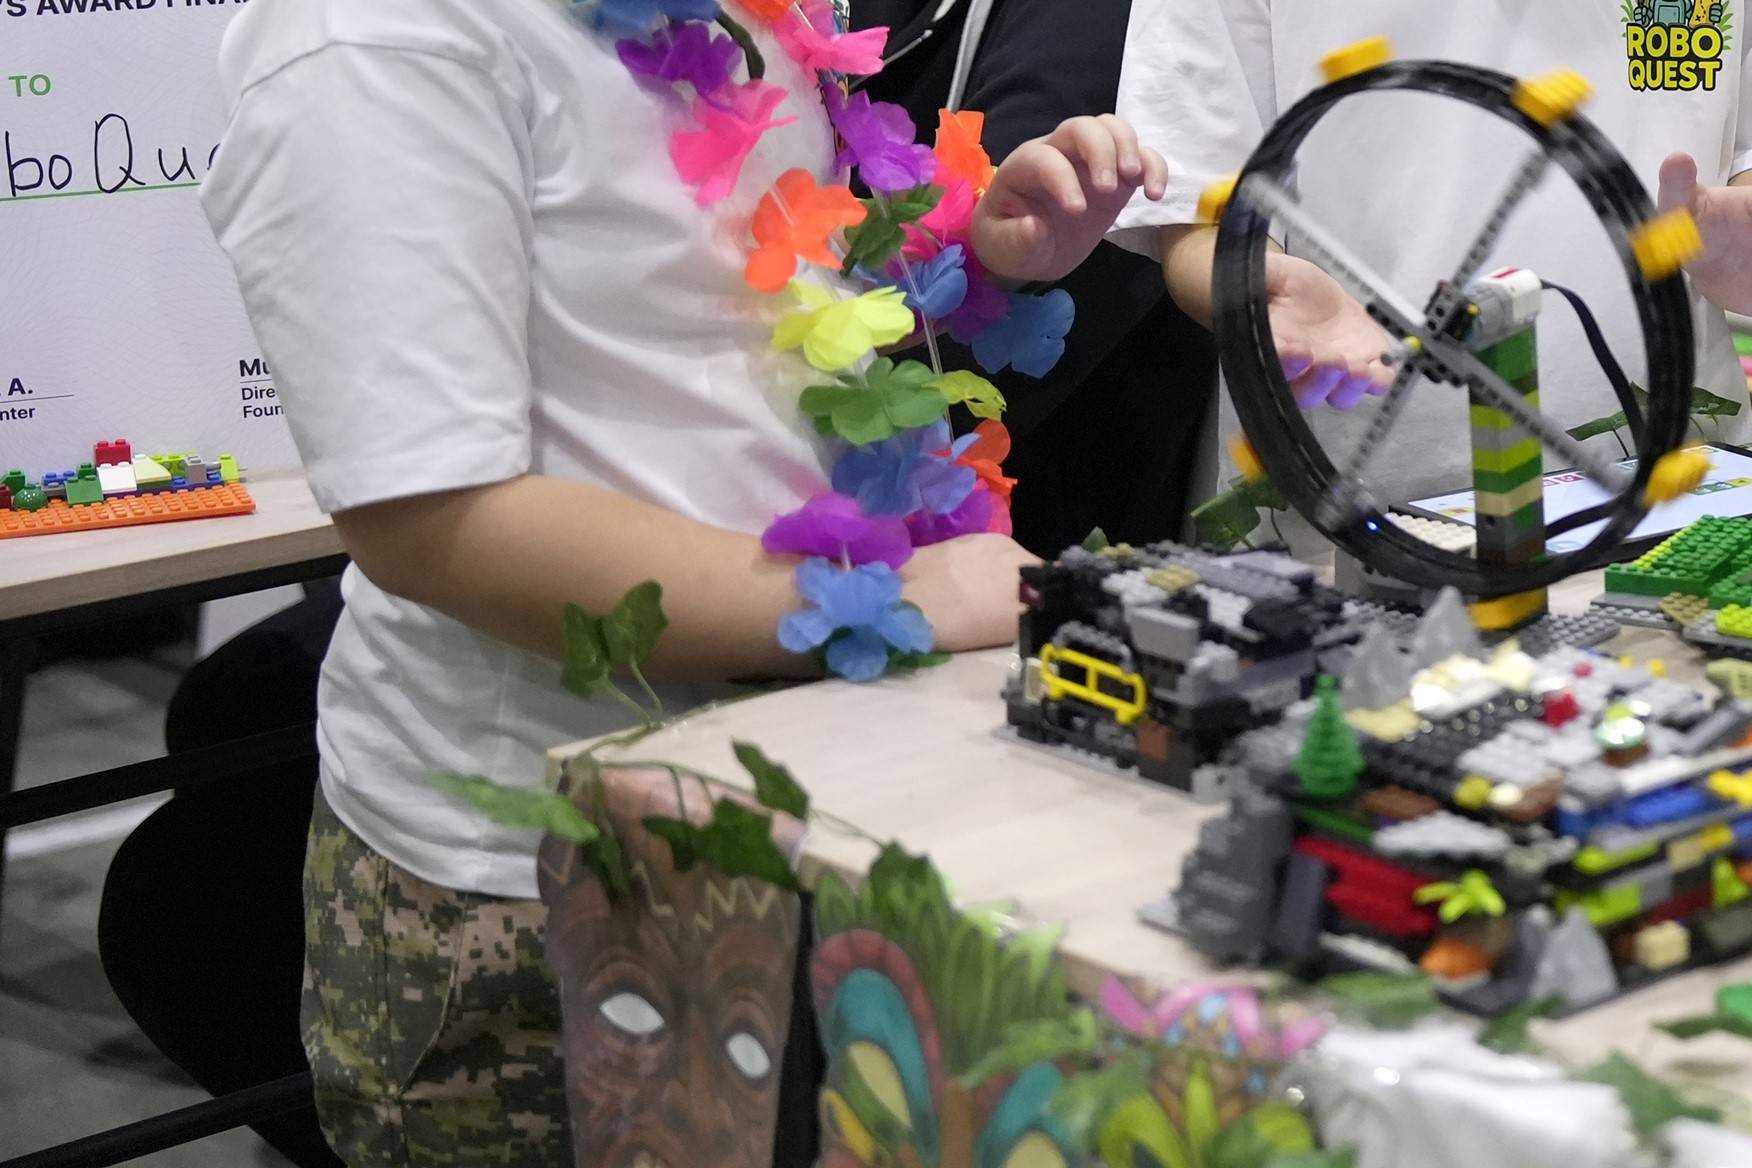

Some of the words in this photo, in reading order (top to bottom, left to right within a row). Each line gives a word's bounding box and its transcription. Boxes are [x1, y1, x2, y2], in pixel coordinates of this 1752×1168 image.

[1626, 25, 1723, 59] ROBO
[8, 74, 52, 97] TO
[1628, 60, 1721, 91] QUEST
[8, 377, 33, 396] A.
[241, 386, 276, 401] Dire
